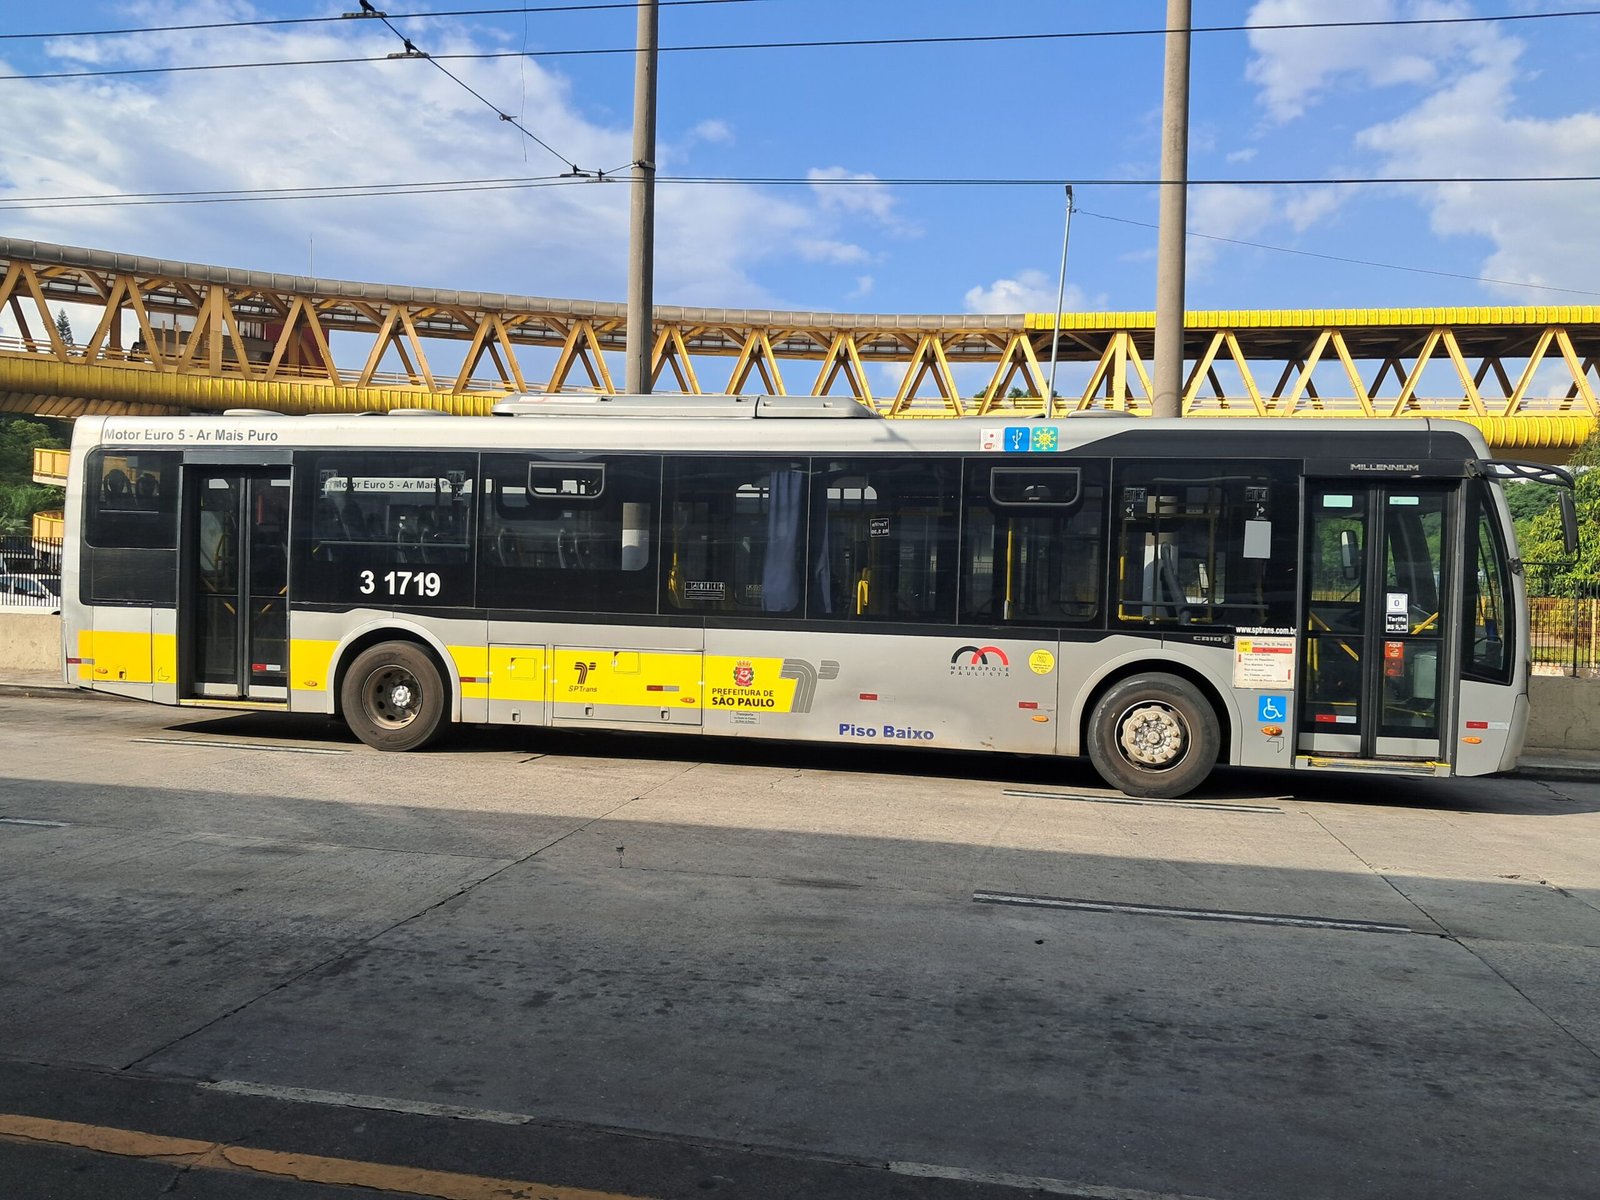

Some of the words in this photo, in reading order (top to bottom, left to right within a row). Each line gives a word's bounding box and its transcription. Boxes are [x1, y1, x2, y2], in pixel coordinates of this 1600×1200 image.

[104, 429, 141, 440] Motor
[144, 429, 174, 441] Euro
[177, 429, 186, 441] 5
[196, 429, 212, 441] Ar
[215, 430, 244, 441] Mais
[248, 430, 278, 441] Puro
[1350, 463, 1419, 471] MILLENNIUM
[363, 480, 386, 489] Euro
[388, 480, 395, 489] 5
[402, 480, 414, 489] Ar
[359, 569, 376, 595] 3
[384, 570, 441, 597] 1719
[1235, 626, 1297, 636] www.sptrans.com.br
[568, 685, 598, 693] SPTrans
[711, 687, 761, 697] PREFEITURA
[763, 689, 774, 697] DE
[711, 694, 735, 706] SÃO
[737, 697, 775, 708] PAULO
[839, 723, 877, 738] Piso
[883, 725, 934, 740] Baixo
